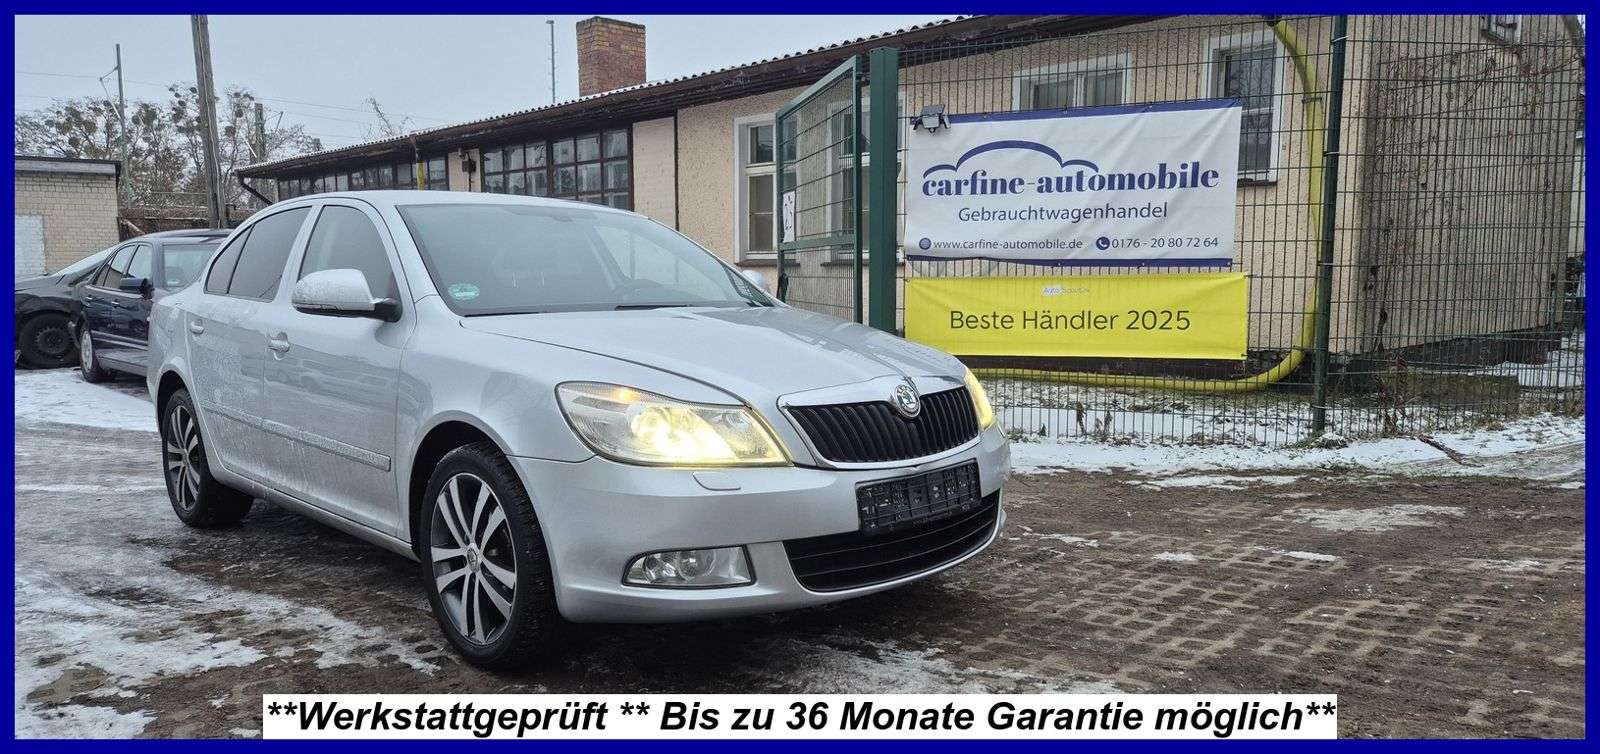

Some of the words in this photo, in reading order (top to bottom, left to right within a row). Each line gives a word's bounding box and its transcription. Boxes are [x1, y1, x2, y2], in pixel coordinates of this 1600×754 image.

[921, 161, 1219, 196] carfine-automobile
[958, 202, 1168, 224] Gebrauchtwagenhandel
[933, 238, 1083, 250] www.carfine-automobile.de
[1111, 238, 1141, 249] 0176
[1150, 237, 1165, 248] 20
[1167, 237, 1183, 248] 80
[1186, 237, 1200, 248] 72
[1203, 237, 1219, 248] 64
[950, 310, 1015, 330] Beste
[1023, 310, 1120, 330] Händler
[1125, 309, 1191, 331] 2025
